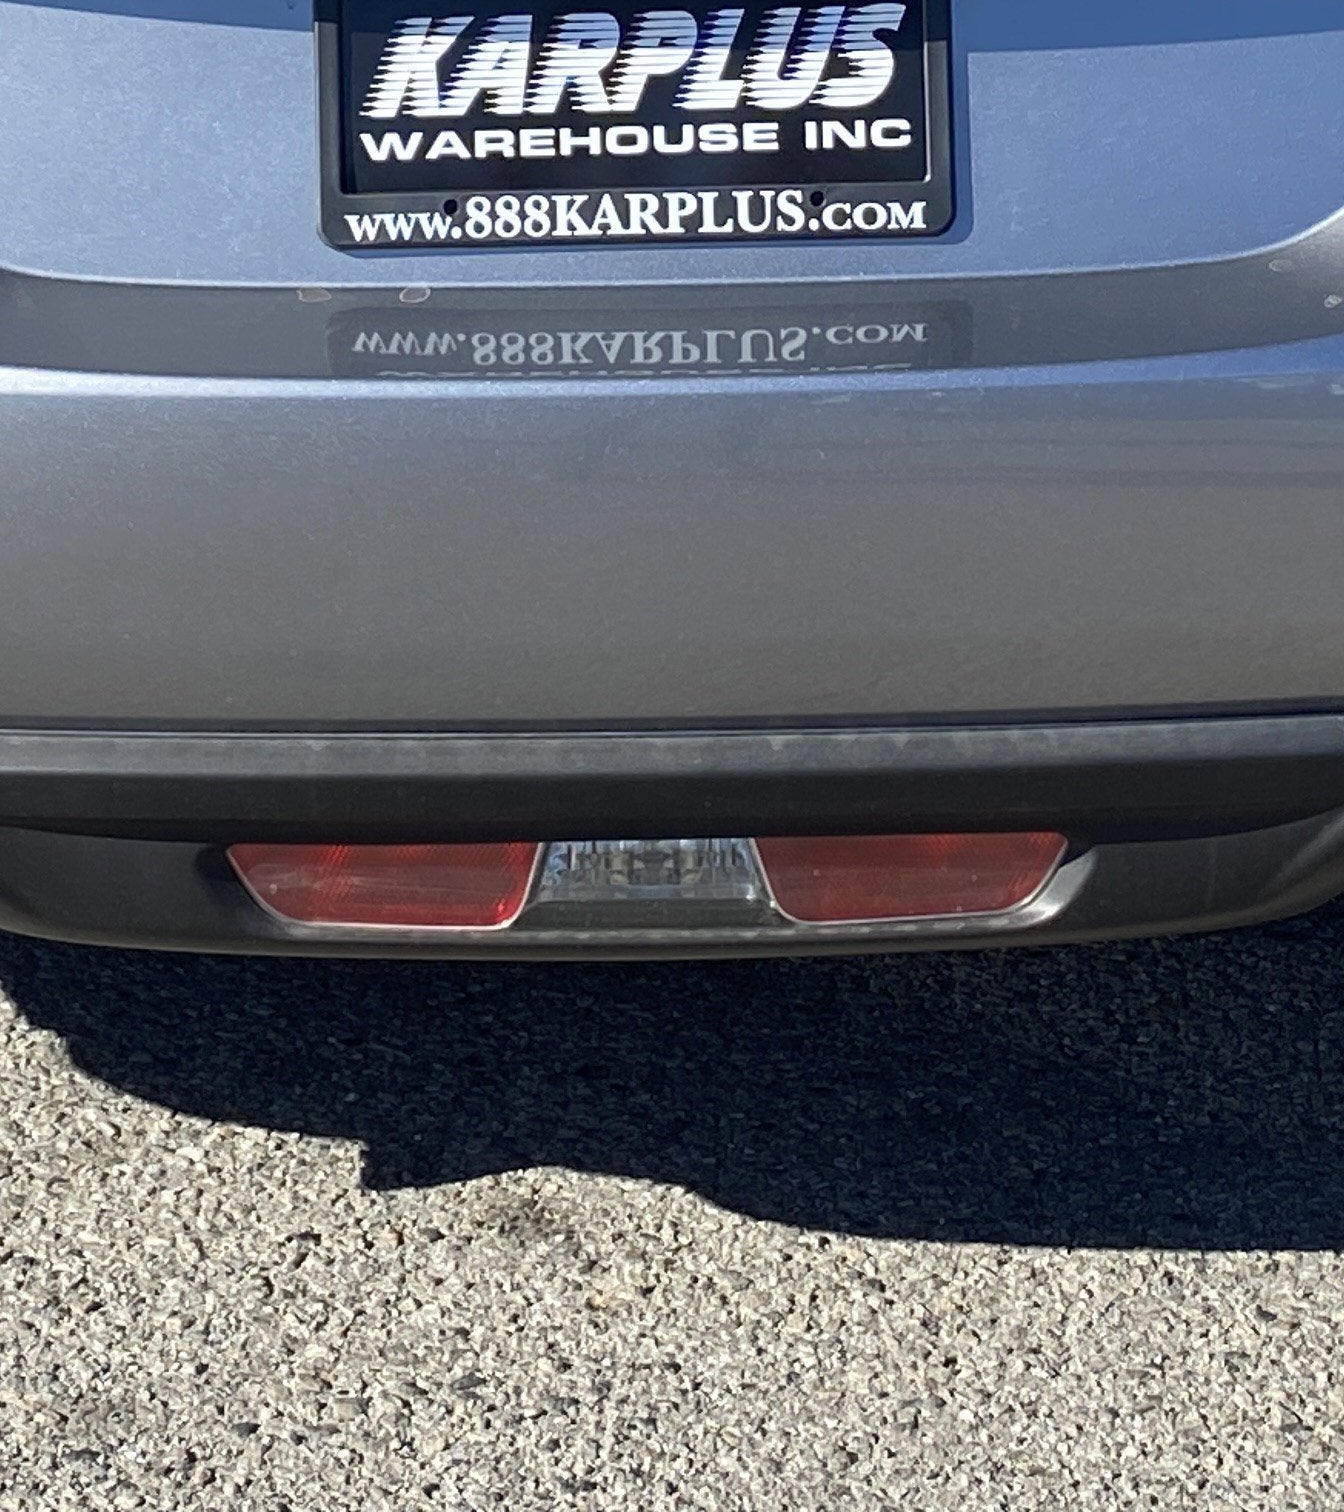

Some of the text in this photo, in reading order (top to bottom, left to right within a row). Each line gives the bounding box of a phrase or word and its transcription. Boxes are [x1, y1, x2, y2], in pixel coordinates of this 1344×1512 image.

[358, 2, 907, 118] KARPLUS
[359, 118, 912, 162] WAREHOUSE INC
